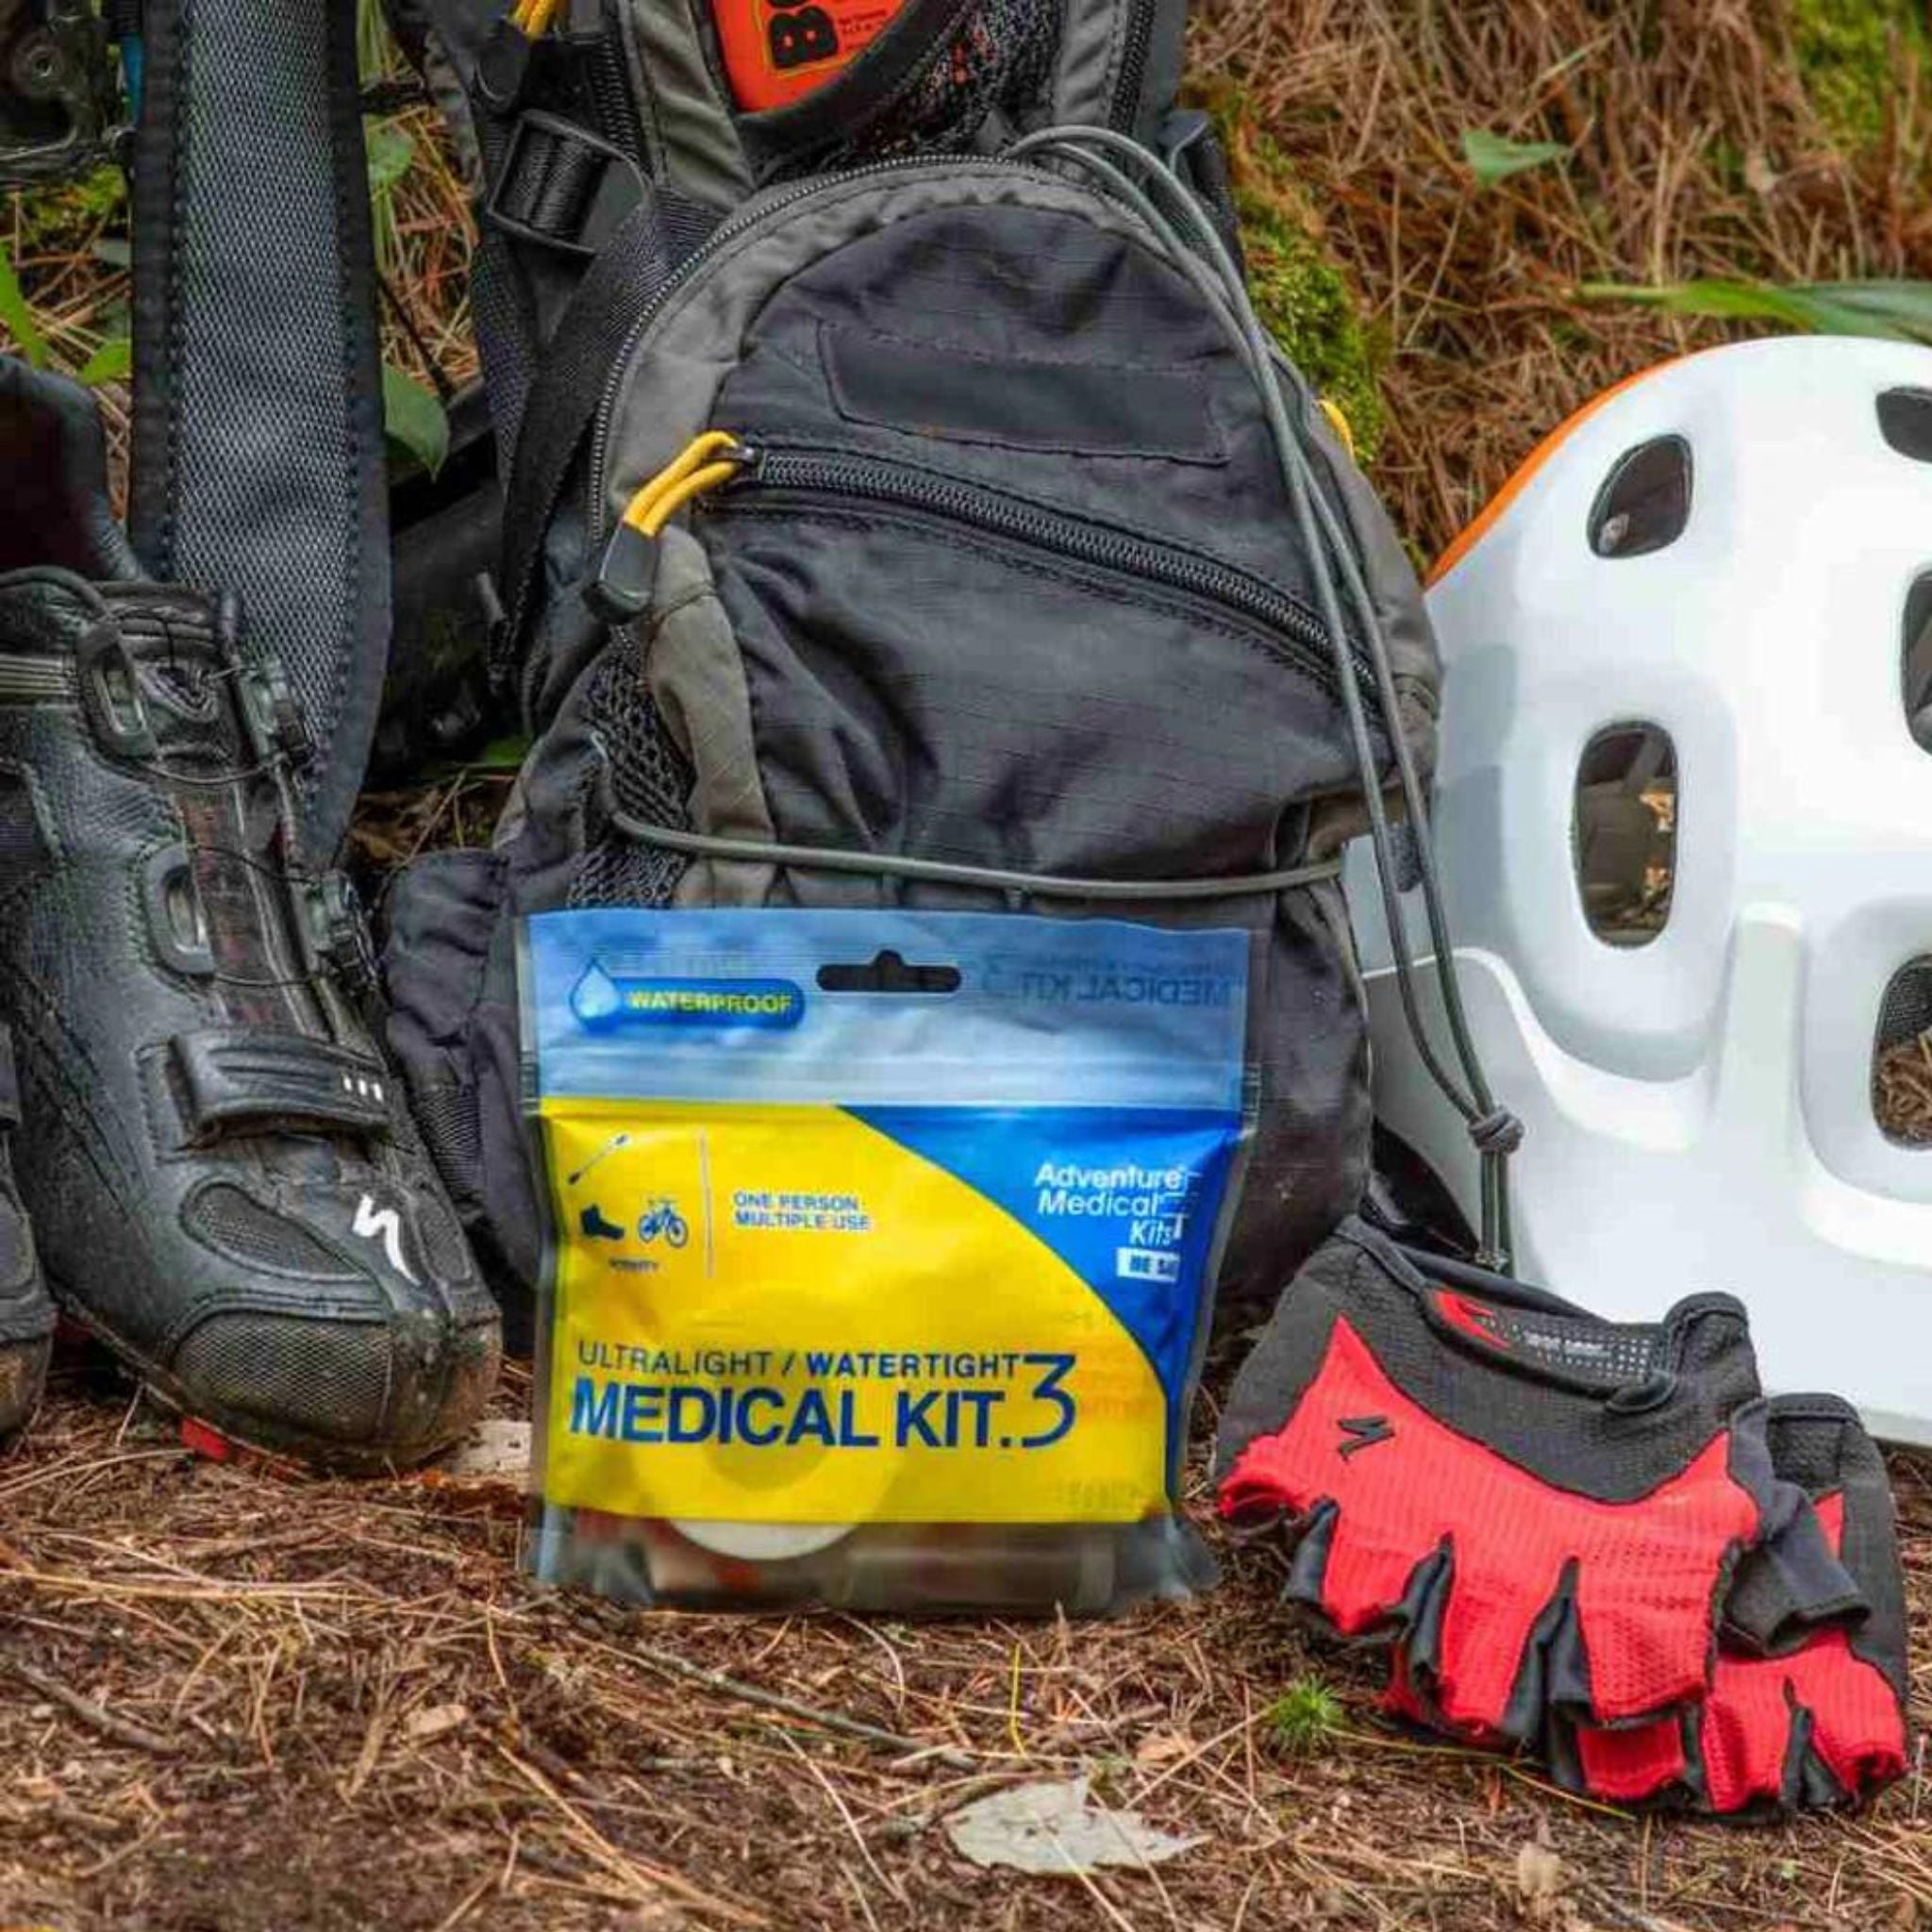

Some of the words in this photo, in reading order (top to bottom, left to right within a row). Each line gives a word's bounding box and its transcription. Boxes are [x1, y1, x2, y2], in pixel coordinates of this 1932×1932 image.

[628, 991, 791, 1014] WATERPROOF
[1035, 1163, 1180, 1190] Adventure
[734, 1191, 771, 1208] ONE
[779, 1194, 858, 1211] PERSON
[1039, 1190, 1158, 1217] Medical
[735, 1210, 826, 1230] MULTIPLE
[578, 1340, 774, 1377] ULTRALIGHT
[806, 1352, 1020, 1379] WATERTIGHT
[570, 1376, 880, 1447] MEDICAL
